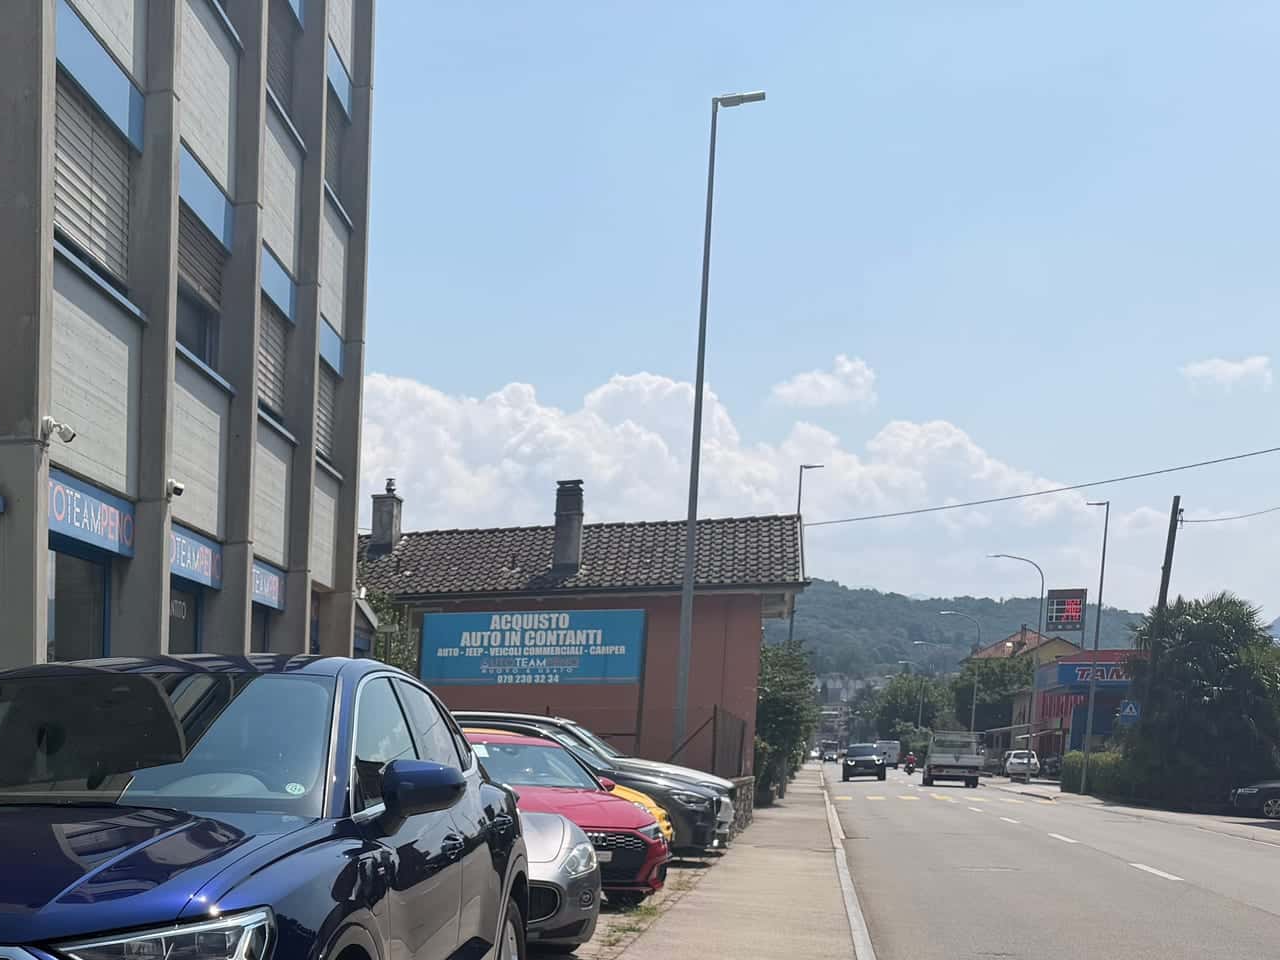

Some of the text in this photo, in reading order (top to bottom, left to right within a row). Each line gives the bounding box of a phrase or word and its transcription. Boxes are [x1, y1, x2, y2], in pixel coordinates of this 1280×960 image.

[490, 613, 569, 630] ACQUISTO
[460, 630, 603, 647] AUTO IN CONTANTI
[437, 648, 459, 657] AUTO
[465, 648, 484, 657] JEEP
[489, 647, 522, 656] VEICOLI
[523, 646, 583, 656] COMMERCIALI
[589, 645, 625, 655] CAMPER
